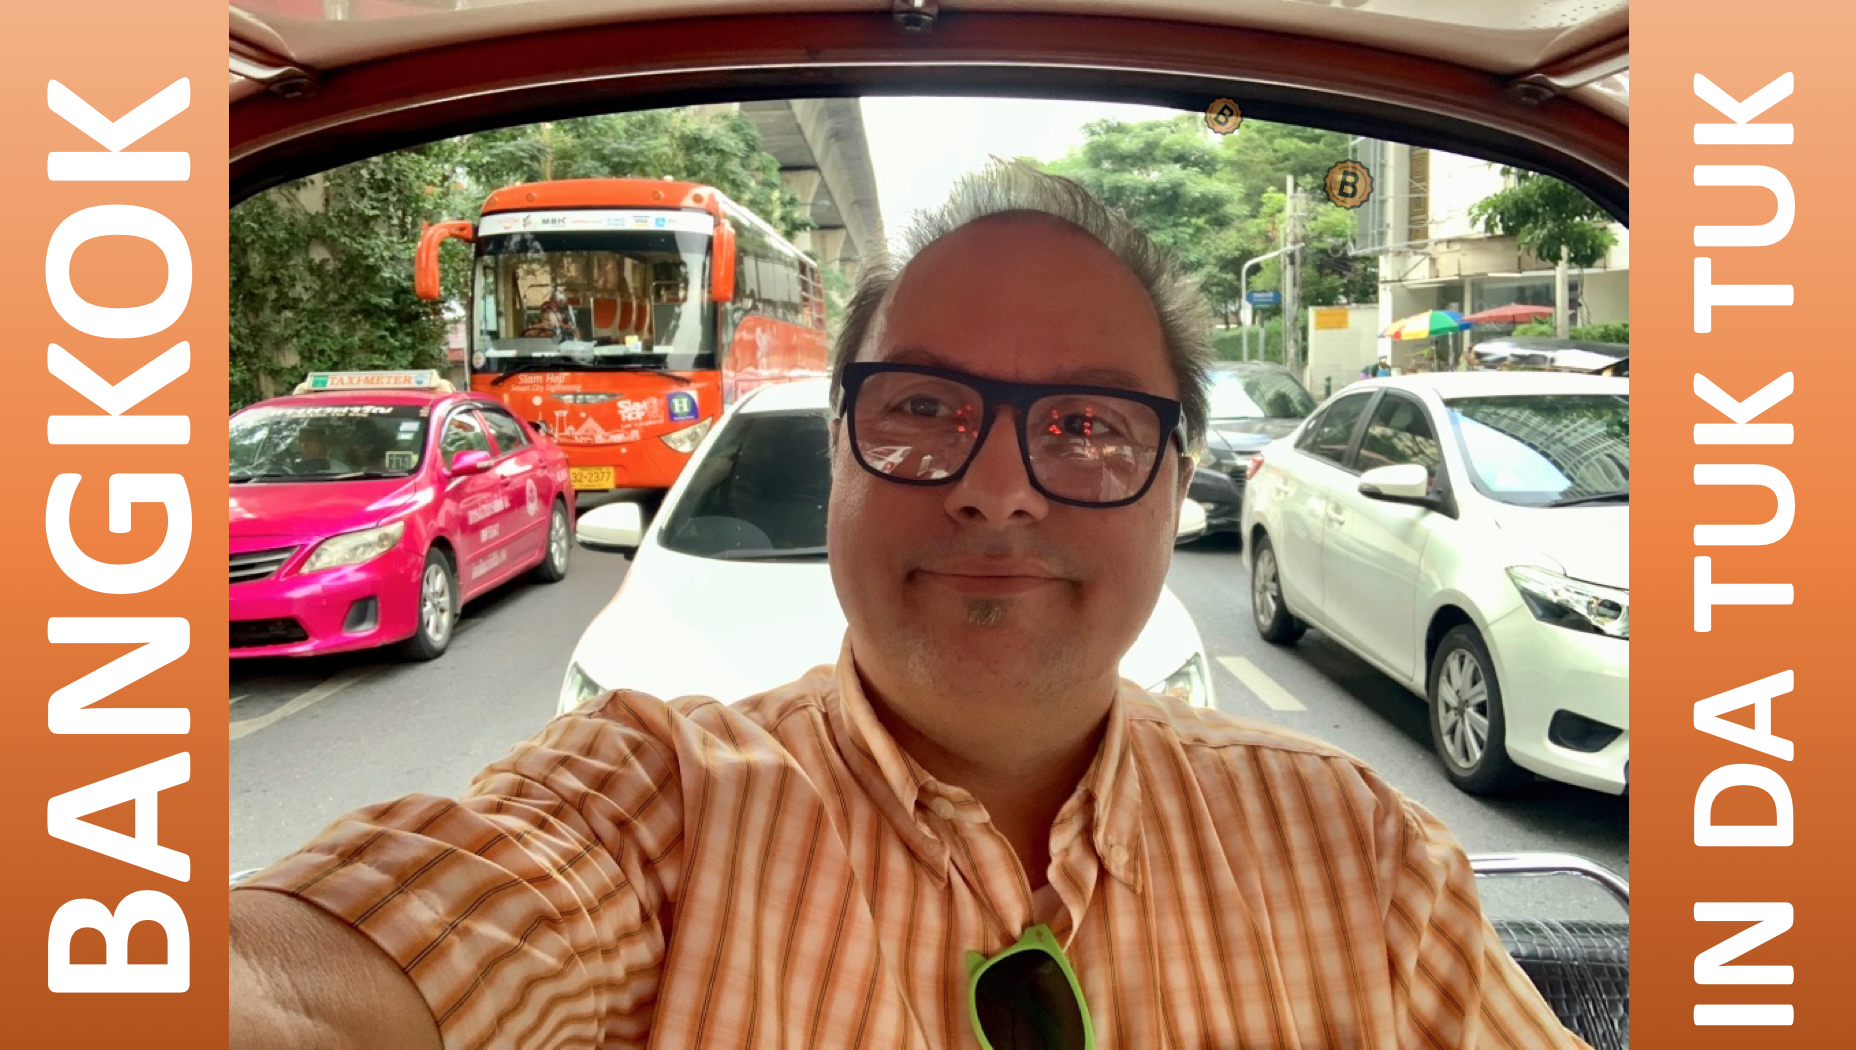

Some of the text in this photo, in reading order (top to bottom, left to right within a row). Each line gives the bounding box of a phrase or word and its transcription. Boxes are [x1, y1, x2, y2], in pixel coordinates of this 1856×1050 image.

[328, 374, 413, 386] TAXI-METER
[671, 397, 689, 414] H
[571, 471, 612, 484] 32-2377
